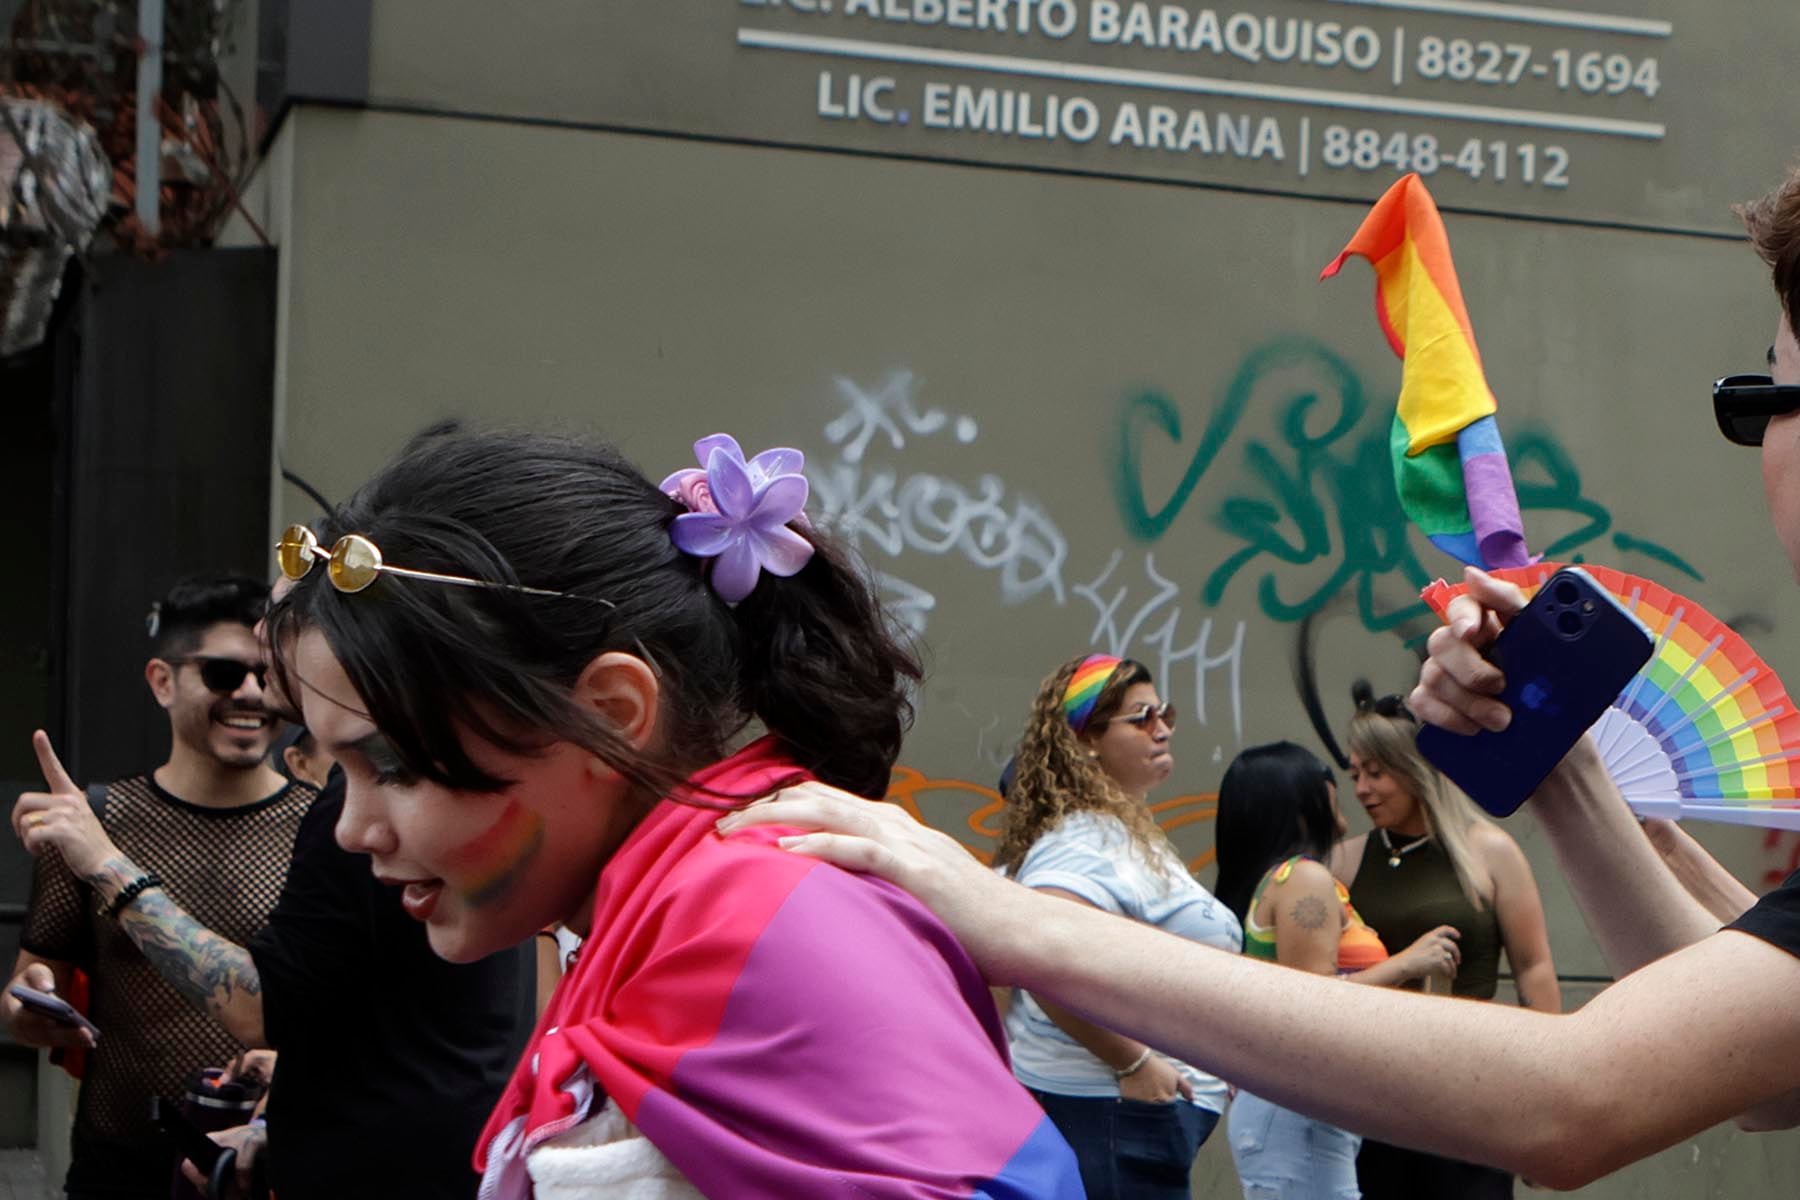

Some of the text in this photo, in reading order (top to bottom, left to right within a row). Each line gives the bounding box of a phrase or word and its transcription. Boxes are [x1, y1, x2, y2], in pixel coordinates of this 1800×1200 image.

[1089, 0, 1381, 69] BARAQUISO
[1416, 36, 1661, 97] 8827-1694
[817, 71, 1570, 188] LIC. EMILIO ARANA 8848-4112
